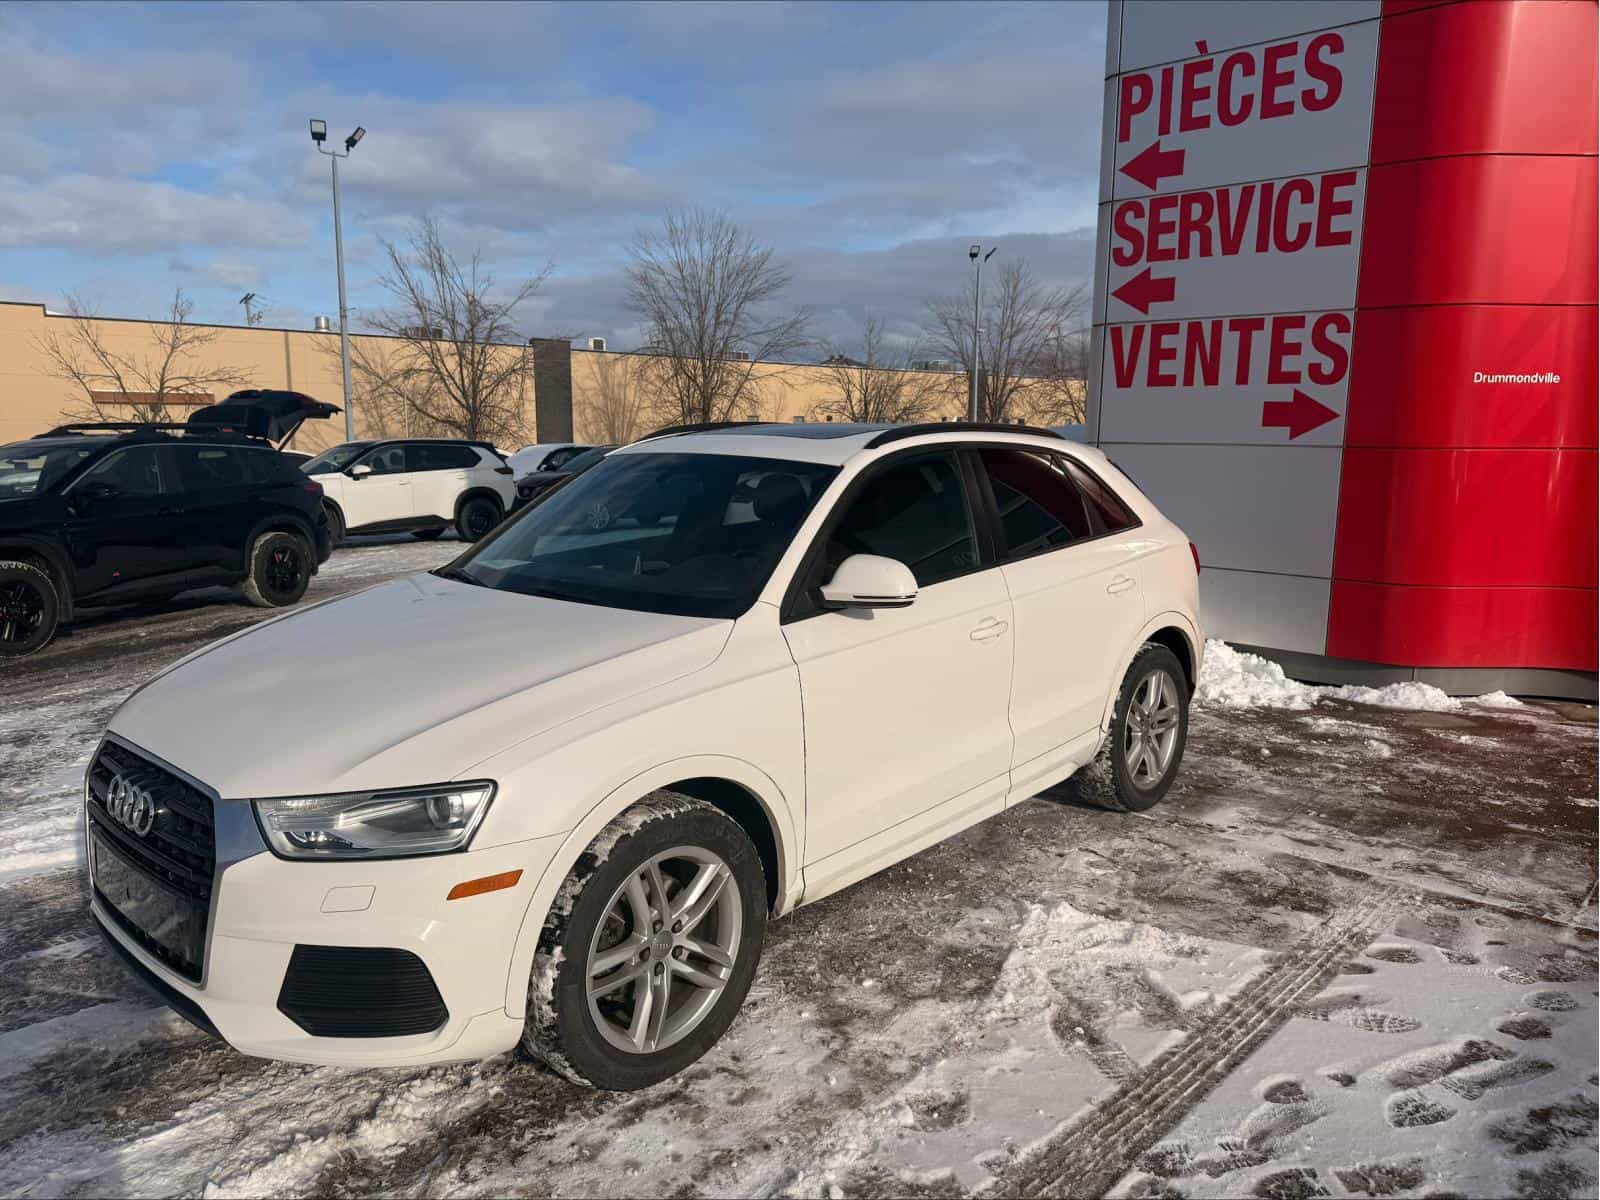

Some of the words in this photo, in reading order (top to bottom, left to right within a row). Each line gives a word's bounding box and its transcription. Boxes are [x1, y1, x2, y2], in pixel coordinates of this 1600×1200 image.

[1118, 32, 1345, 143] PIÈCES
[1112, 171, 1357, 267] SERVICE
[1109, 312, 1352, 389] VENTES
[1473, 371, 1561, 384] Drummondville
